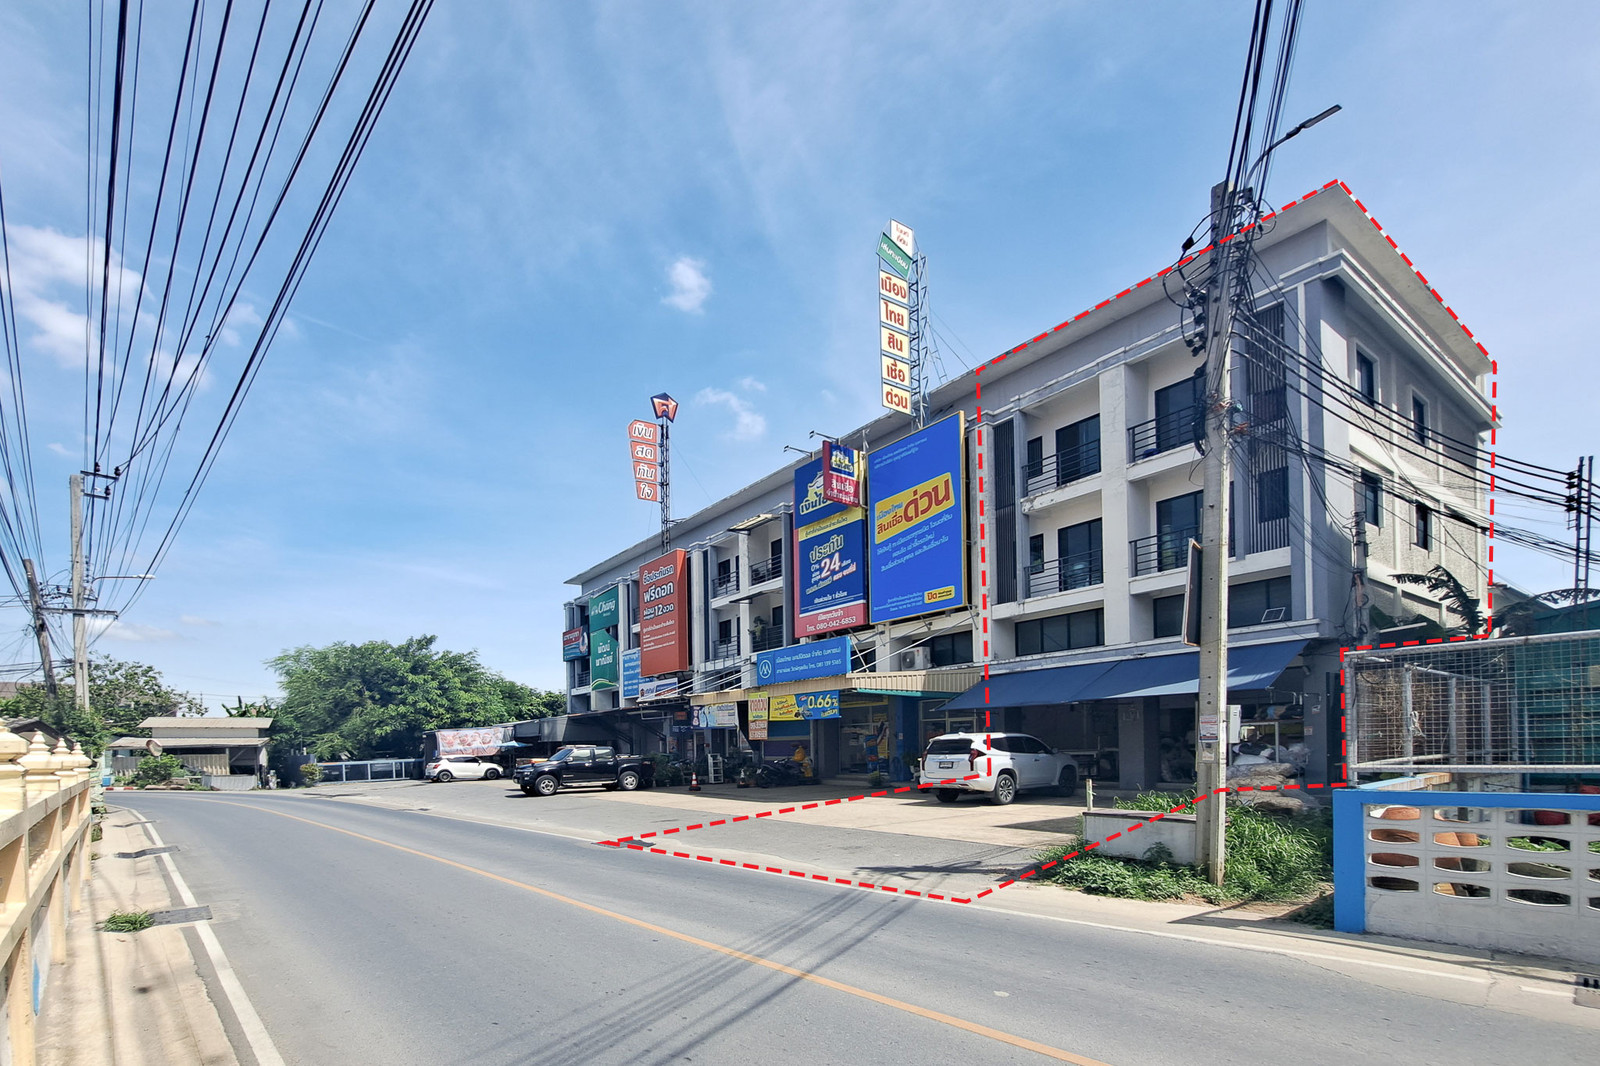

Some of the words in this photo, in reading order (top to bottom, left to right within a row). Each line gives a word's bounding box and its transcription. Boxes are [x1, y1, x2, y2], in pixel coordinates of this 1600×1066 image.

[881, 276, 907, 299] เมือง
[884, 301, 904, 327] ไทย
[887, 333, 903, 352] สิน
[886, 360, 906, 383] เชื่อ
[885, 389, 908, 409] ด่วน
[632, 423, 654, 439] เงิน
[635, 445, 653, 459] สด
[636, 464, 654, 479] ทัน
[640, 482, 653, 499] ใจ
[831, 479, 854, 493] สินเชื่อ
[876, 501, 904, 521] เมืองไทย
[877, 512, 903, 535] สินเชื่อ
[903, 478, 951, 523] ด่วน
[809, 534, 844, 564] ประกัน
[643, 564, 674, 585] ซื้อประกันรถ
[820, 551, 841, 579] 24
[643, 581, 674, 603] ฟรีดอก
[598, 600, 616, 614] Chang
[654, 604, 663, 617] 12
[662, 603, 674, 615] งวด
[808, 694, 838, 708] 0.66%
